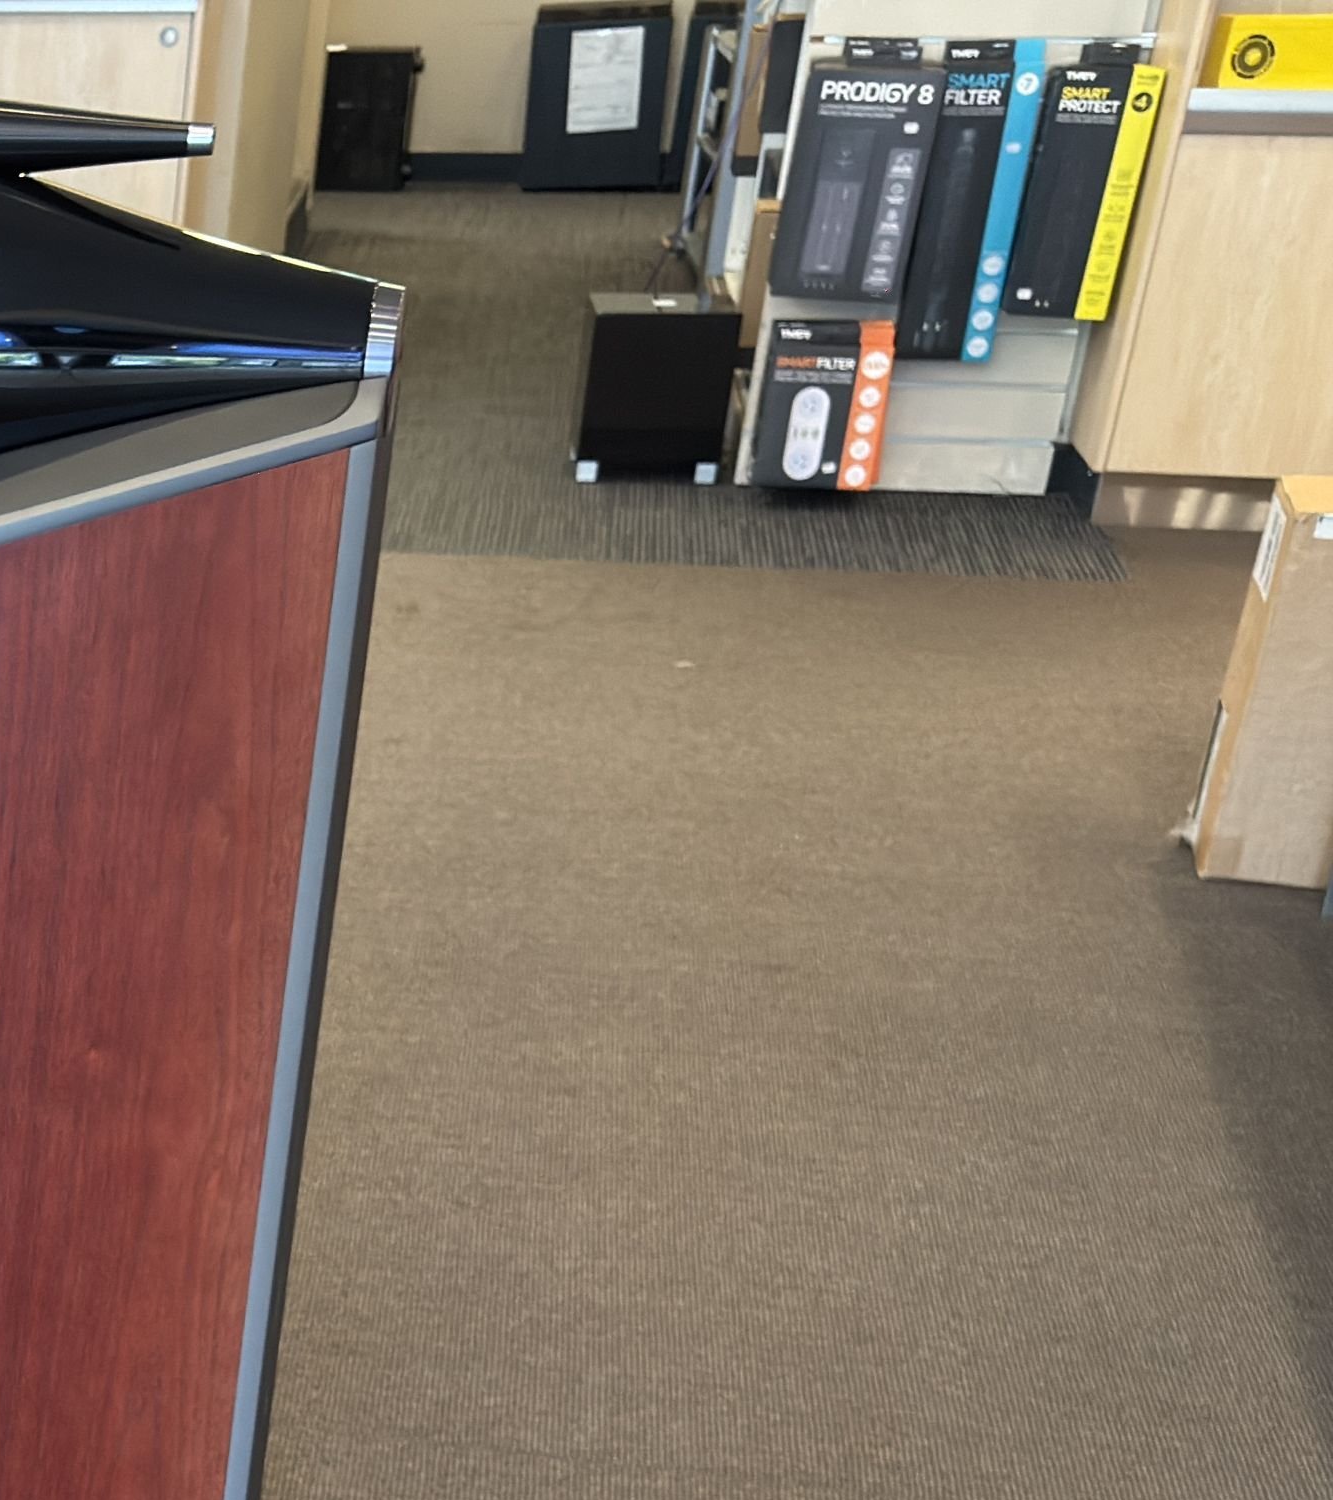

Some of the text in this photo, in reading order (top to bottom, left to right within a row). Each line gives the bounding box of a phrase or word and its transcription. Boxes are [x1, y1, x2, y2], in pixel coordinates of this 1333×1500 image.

[949, 73, 1010, 89] SMART
[820, 80, 935, 105] PRODIGY 8
[944, 89, 1003, 105] FILTER
[1061, 87, 1111, 99] SMART
[1058, 99, 1122, 113] PROTECT
